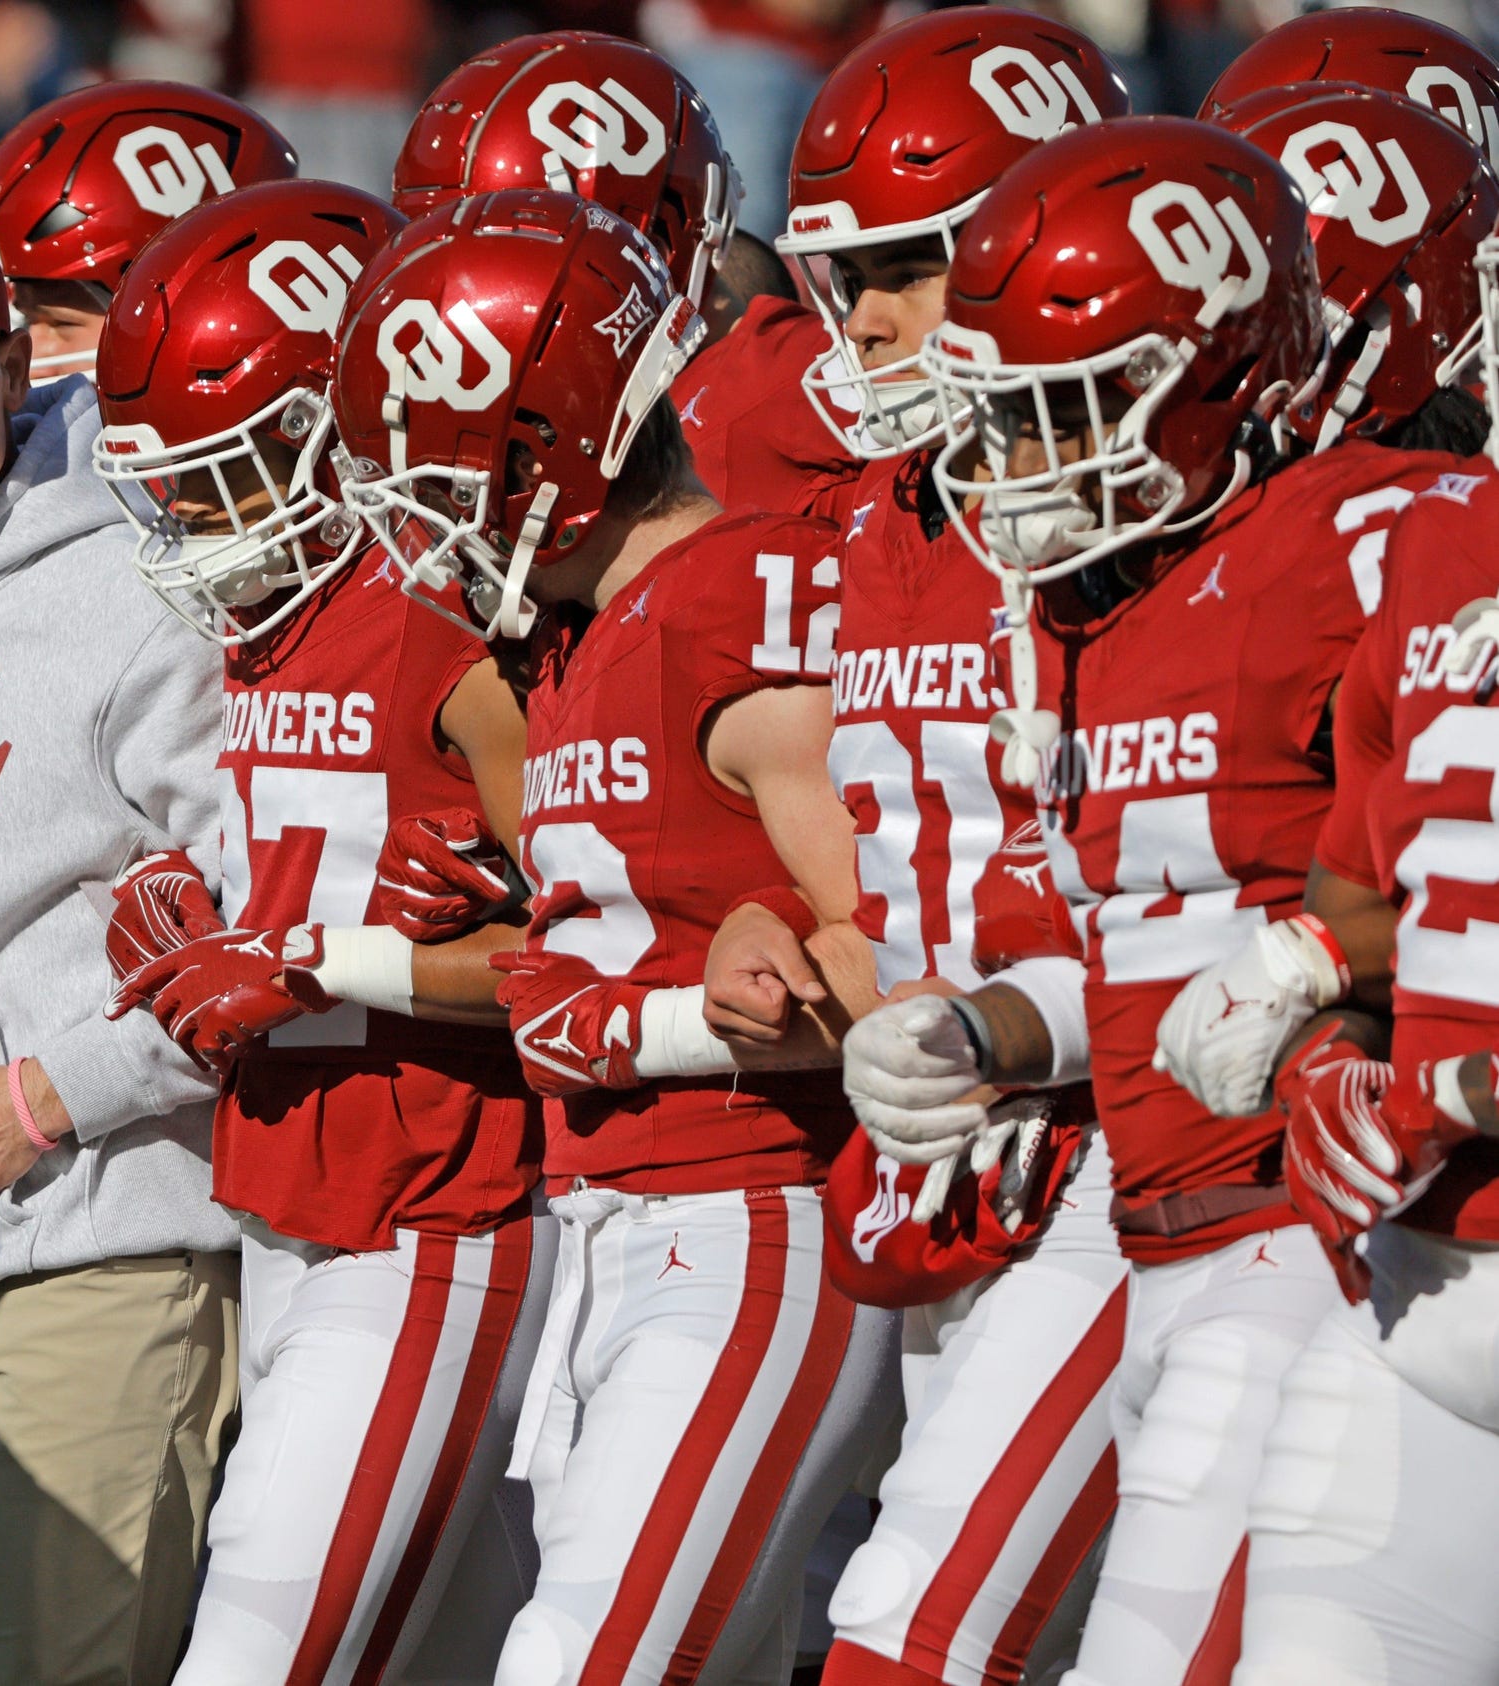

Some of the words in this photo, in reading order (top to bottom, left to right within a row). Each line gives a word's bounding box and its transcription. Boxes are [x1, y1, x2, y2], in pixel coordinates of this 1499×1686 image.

[528, 77, 666, 176] OU
[1280, 121, 1430, 247] OU
[1406, 66, 1499, 176] O
[1128, 181, 1270, 312] OU
[377, 299, 511, 412] OU
[214, 766, 389, 1047] 7
[518, 822, 657, 976] 2
[1035, 792, 1270, 984] 4
